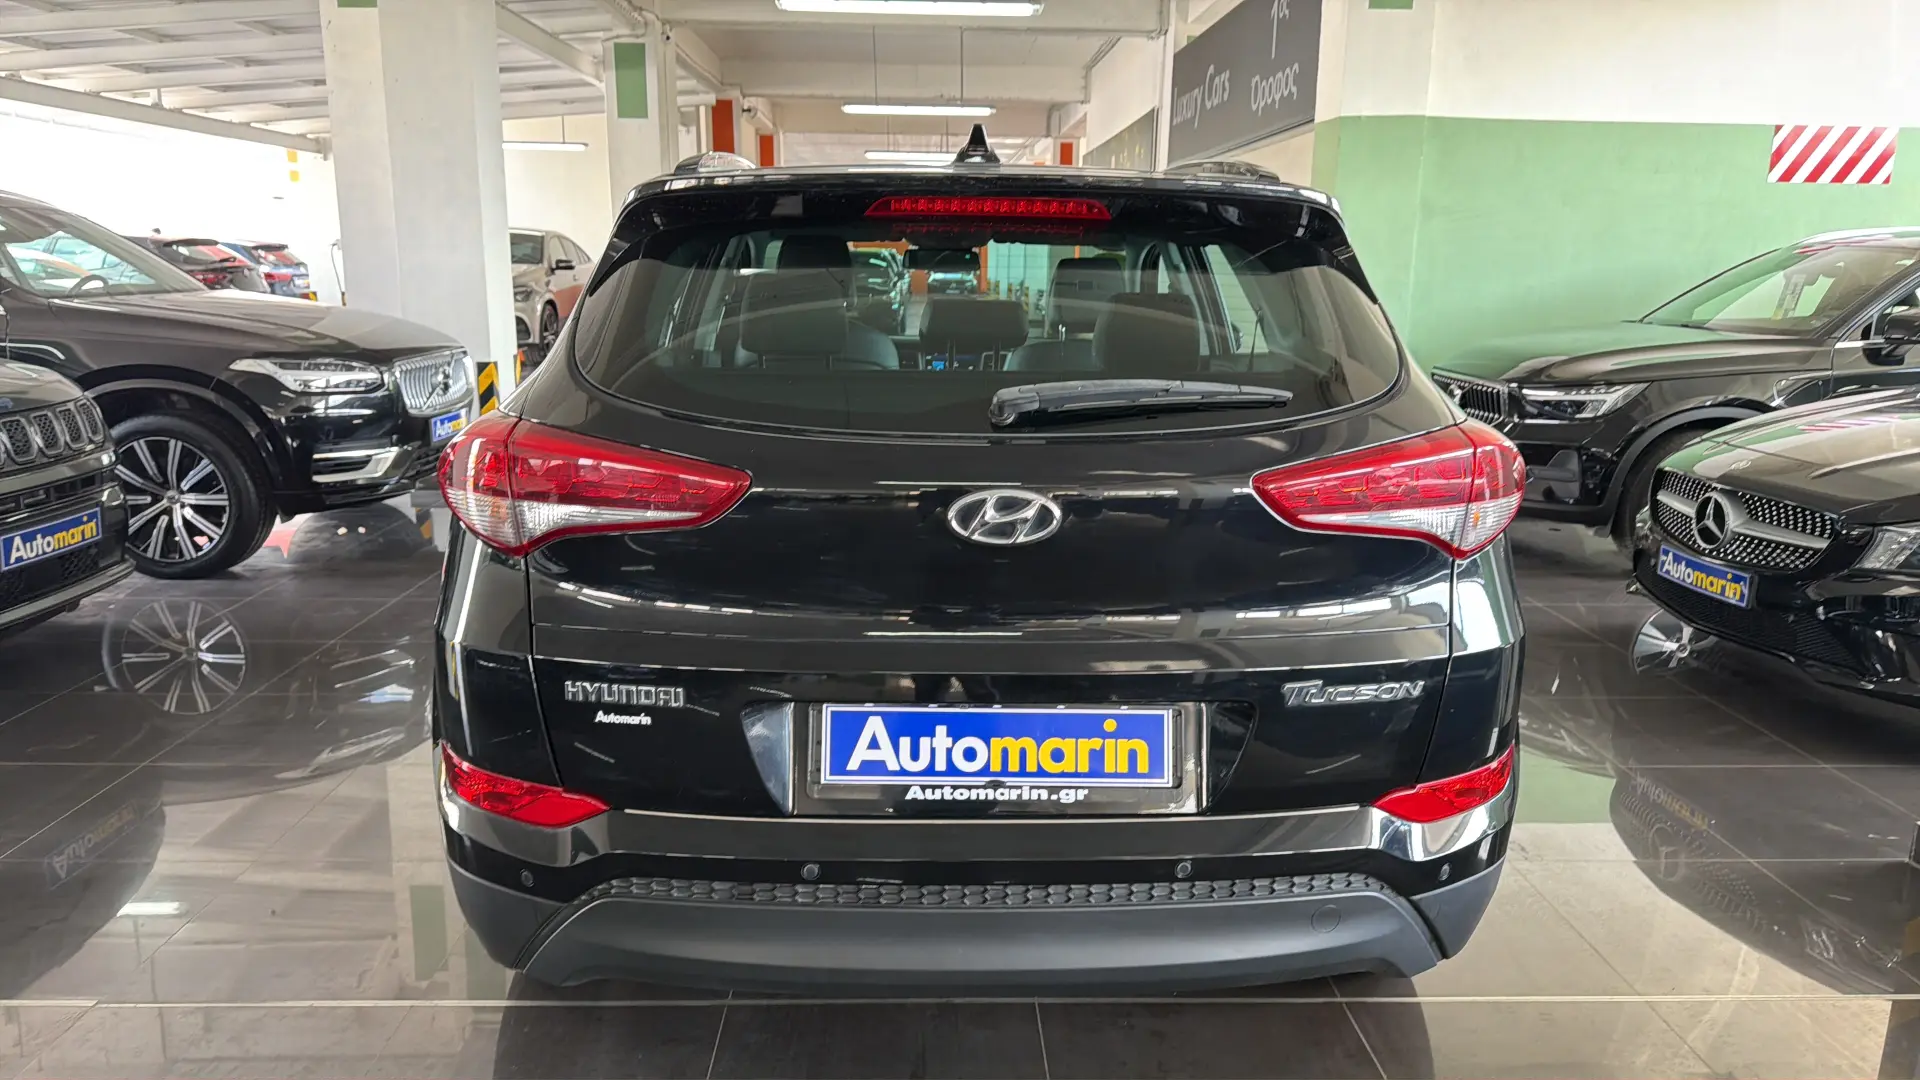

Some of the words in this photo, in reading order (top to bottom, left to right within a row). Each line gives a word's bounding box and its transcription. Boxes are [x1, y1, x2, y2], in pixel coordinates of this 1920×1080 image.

[1172, 84, 1204, 129] Luxury
[1205, 64, 1230, 111] Cars
[9, 515, 97, 564] Automarin
[1662, 551, 1741, 600] Automarin
[564, 680, 686, 708] HYUNDAI
[594, 710, 652, 725] Automarin
[845, 715, 1149, 774] Automarin
[905, 785, 1088, 804] Automarin.gr
